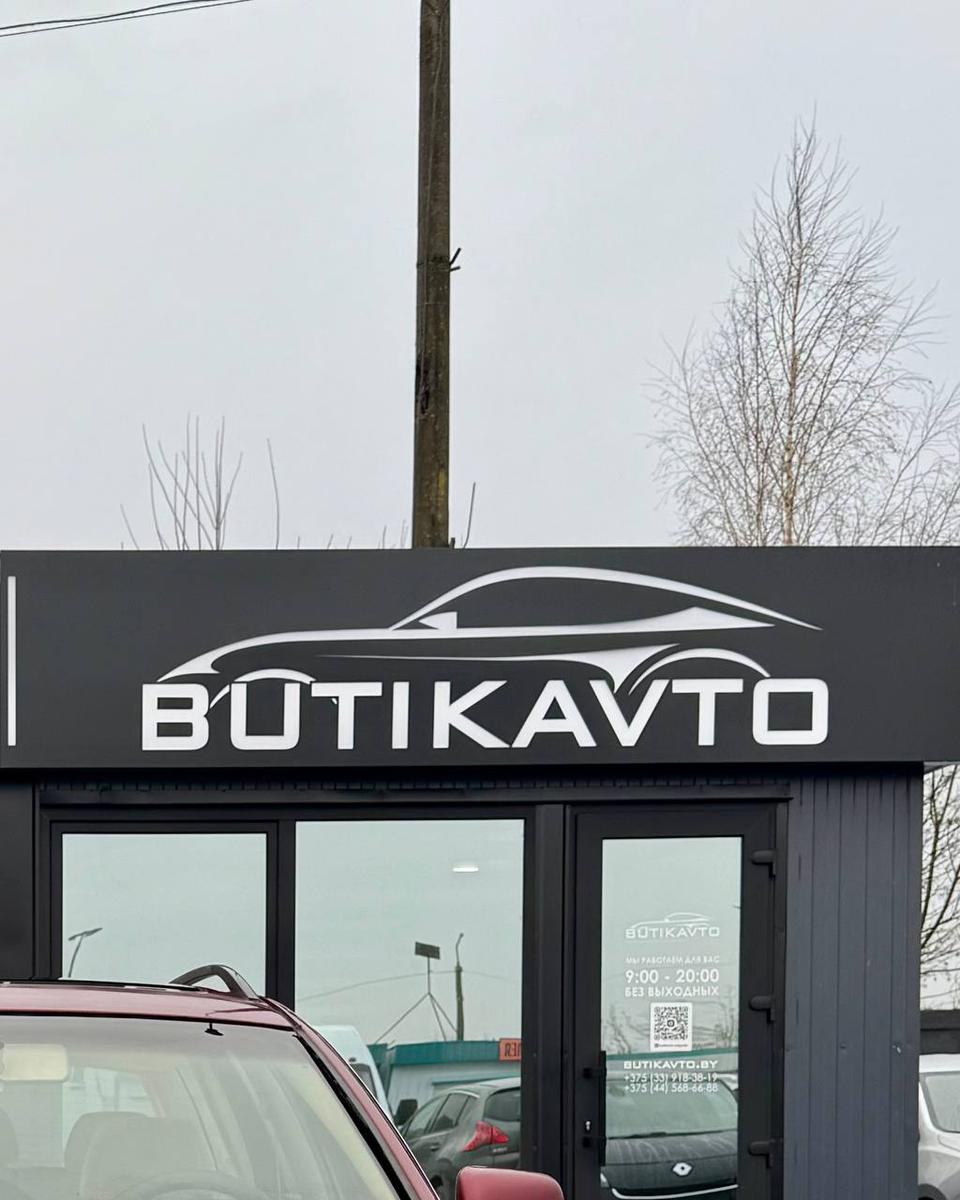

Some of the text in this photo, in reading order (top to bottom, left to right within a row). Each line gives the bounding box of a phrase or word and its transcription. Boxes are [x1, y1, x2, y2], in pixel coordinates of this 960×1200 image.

[141, 677, 829, 751] BUTIKAVTO
[625, 926, 720, 939] BUTIKAVTO
[625, 969, 659, 984] 9:00
[675, 969, 720, 983] 20:00
[625, 986, 720, 998] БЕЗ ВЫХОДНЫХ
[623, 1060, 719, 1069] BUTIKAVTO.BY
[624, 1072, 718, 1085] +375 (33) 918-38-19
[624, 1083, 719, 1095] +375 (44) 568-66-88
